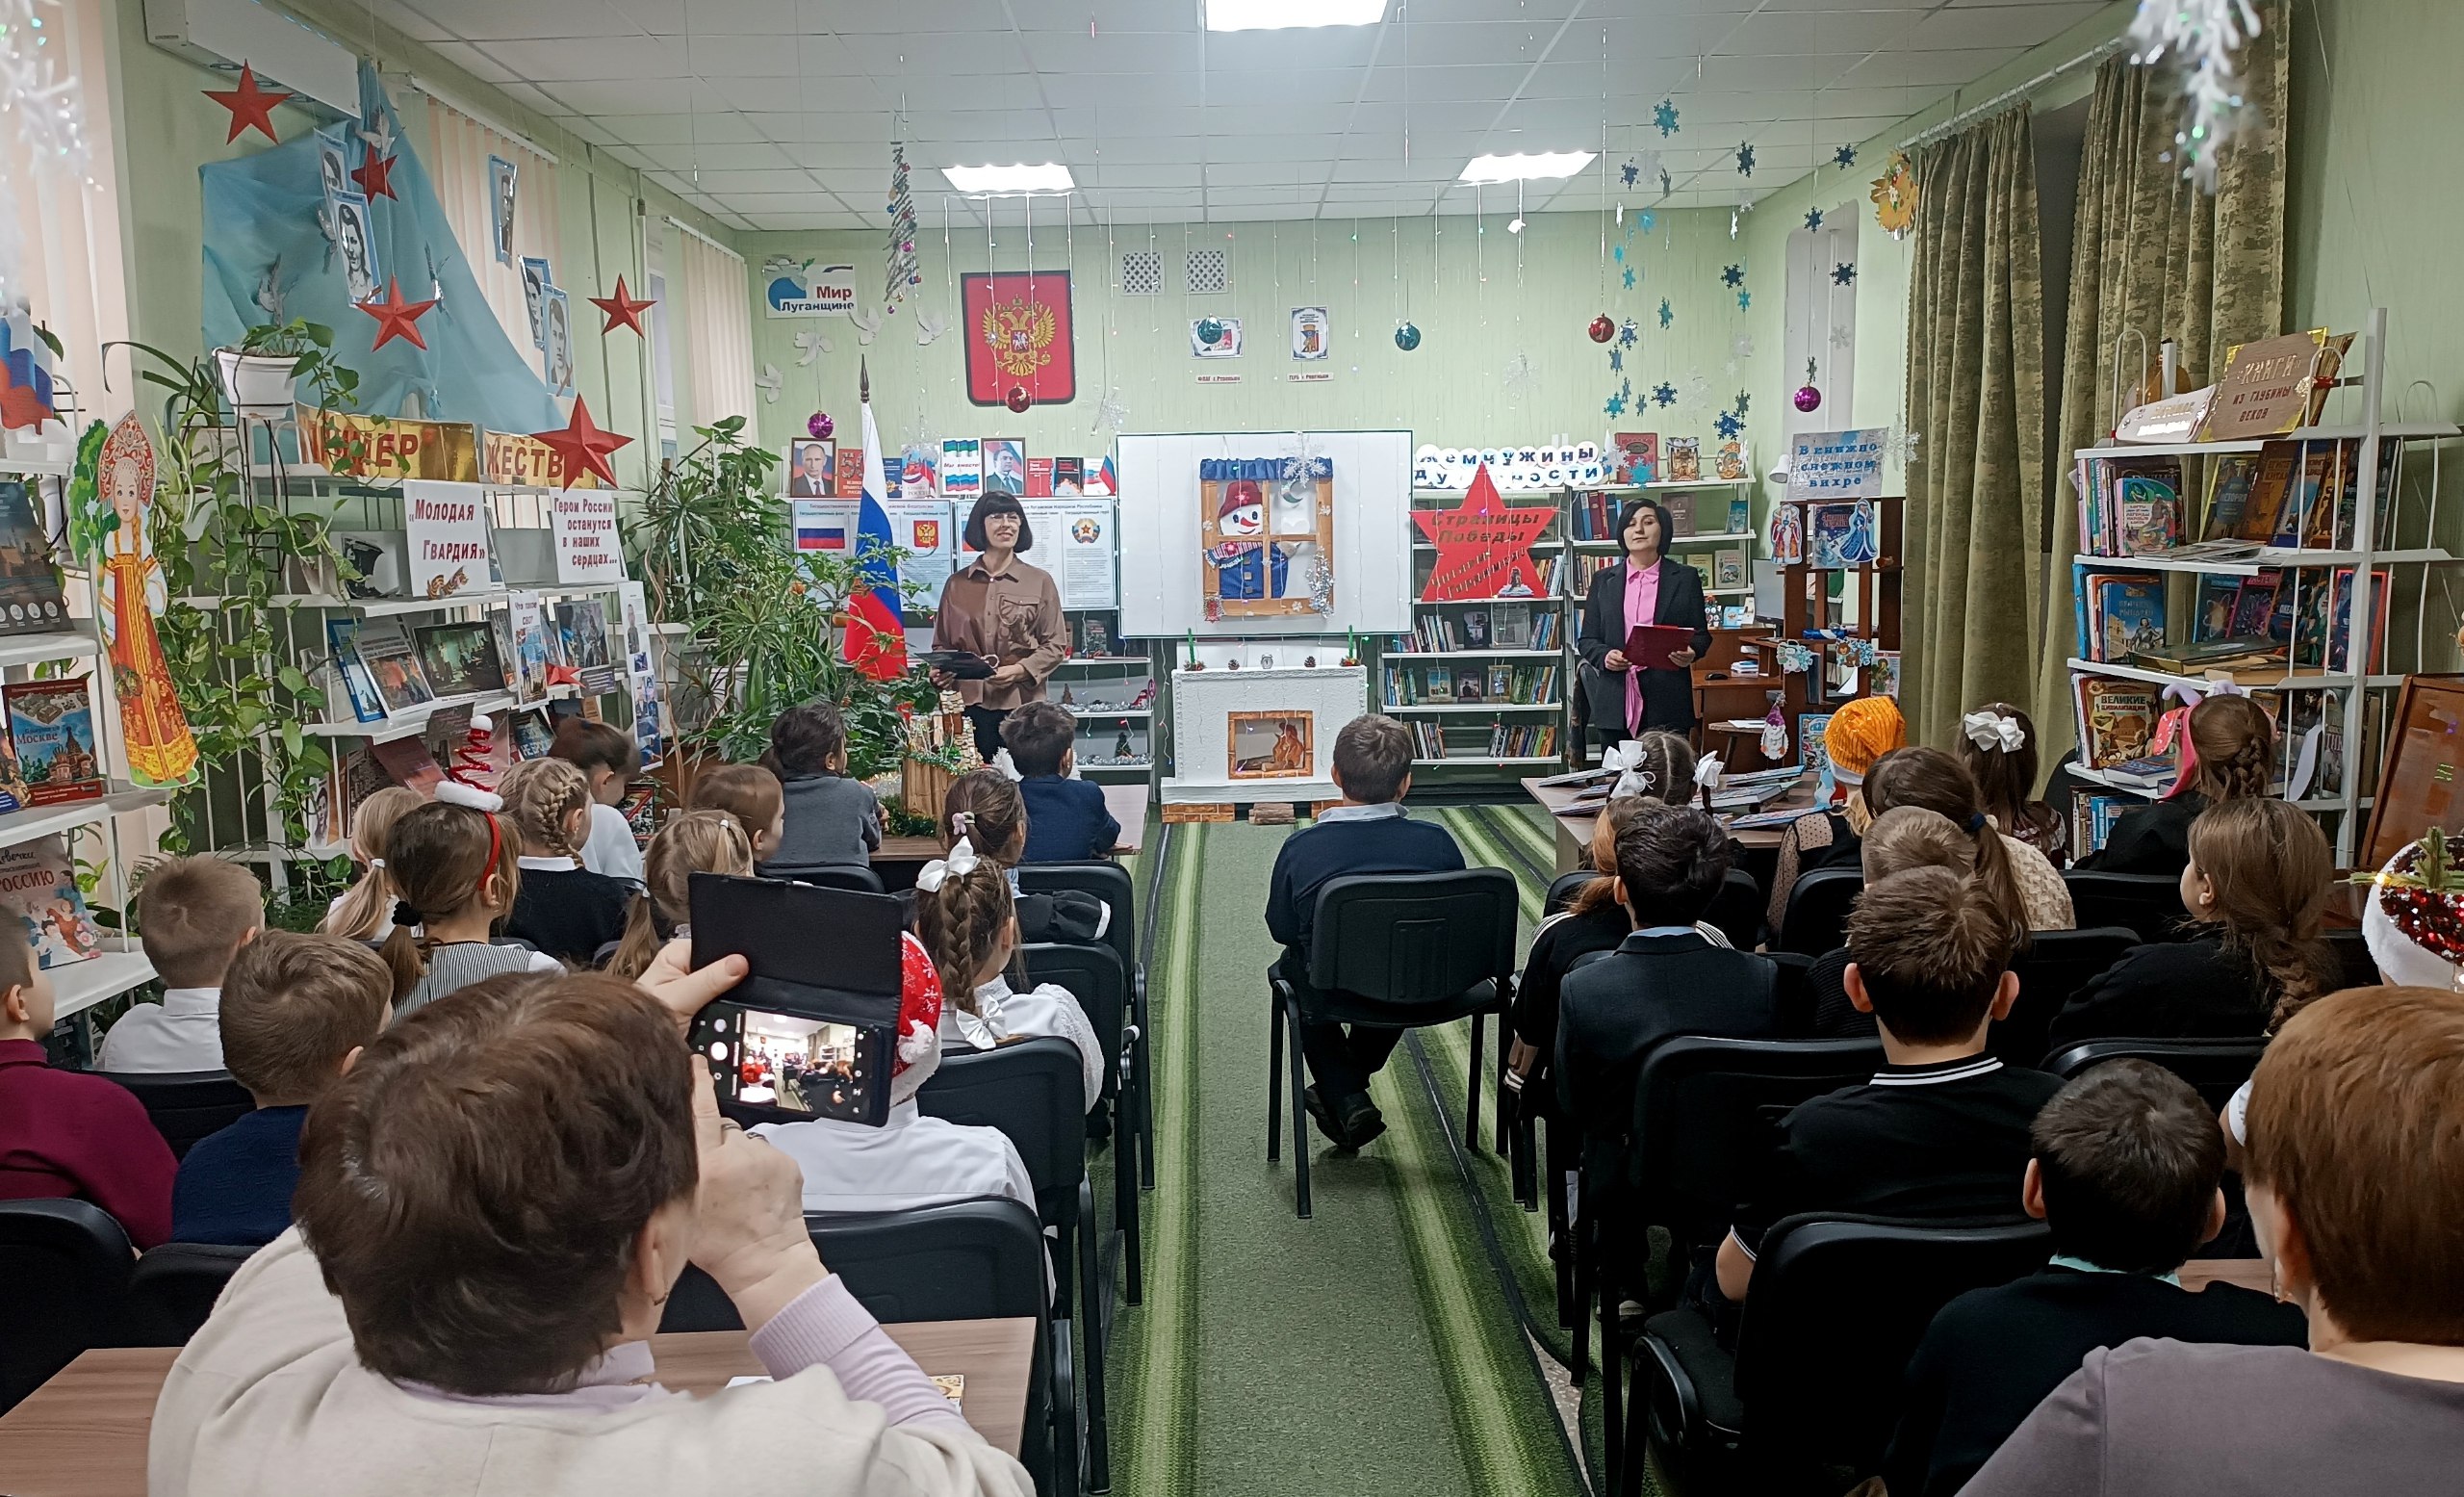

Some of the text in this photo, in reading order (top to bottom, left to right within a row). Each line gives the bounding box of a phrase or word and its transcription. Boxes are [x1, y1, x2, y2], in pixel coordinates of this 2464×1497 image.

[816, 286, 852, 300] Мир
[781, 301, 855, 313] Луганщине
[2233, 393, 2246, 405] ИЗ
[2239, 407, 2269, 422] ВЕКОВ
[1799, 445, 1810, 455] В
[486, 441, 584, 478] ЖЕСТВ
[1801, 460, 1876, 471] снежном
[1810, 477, 1861, 488] вихре
[554, 497, 613, 515] Герои России
[568, 520, 612, 533] останутся
[1431, 513, 1540, 527] Страницы
[563, 536, 601, 548] в наших
[1438, 530, 1525, 544] Победы
[424, 540, 485, 563] ГВАРДИЯ»
[572, 554, 618, 570] сердцах...
[2101, 695, 2146, 705] ВЕЛИКИЕ
[16, 733, 59, 745] Москве
[0, 849, 36, 865] евочки
[0, 870, 55, 892] ОССИЮ
